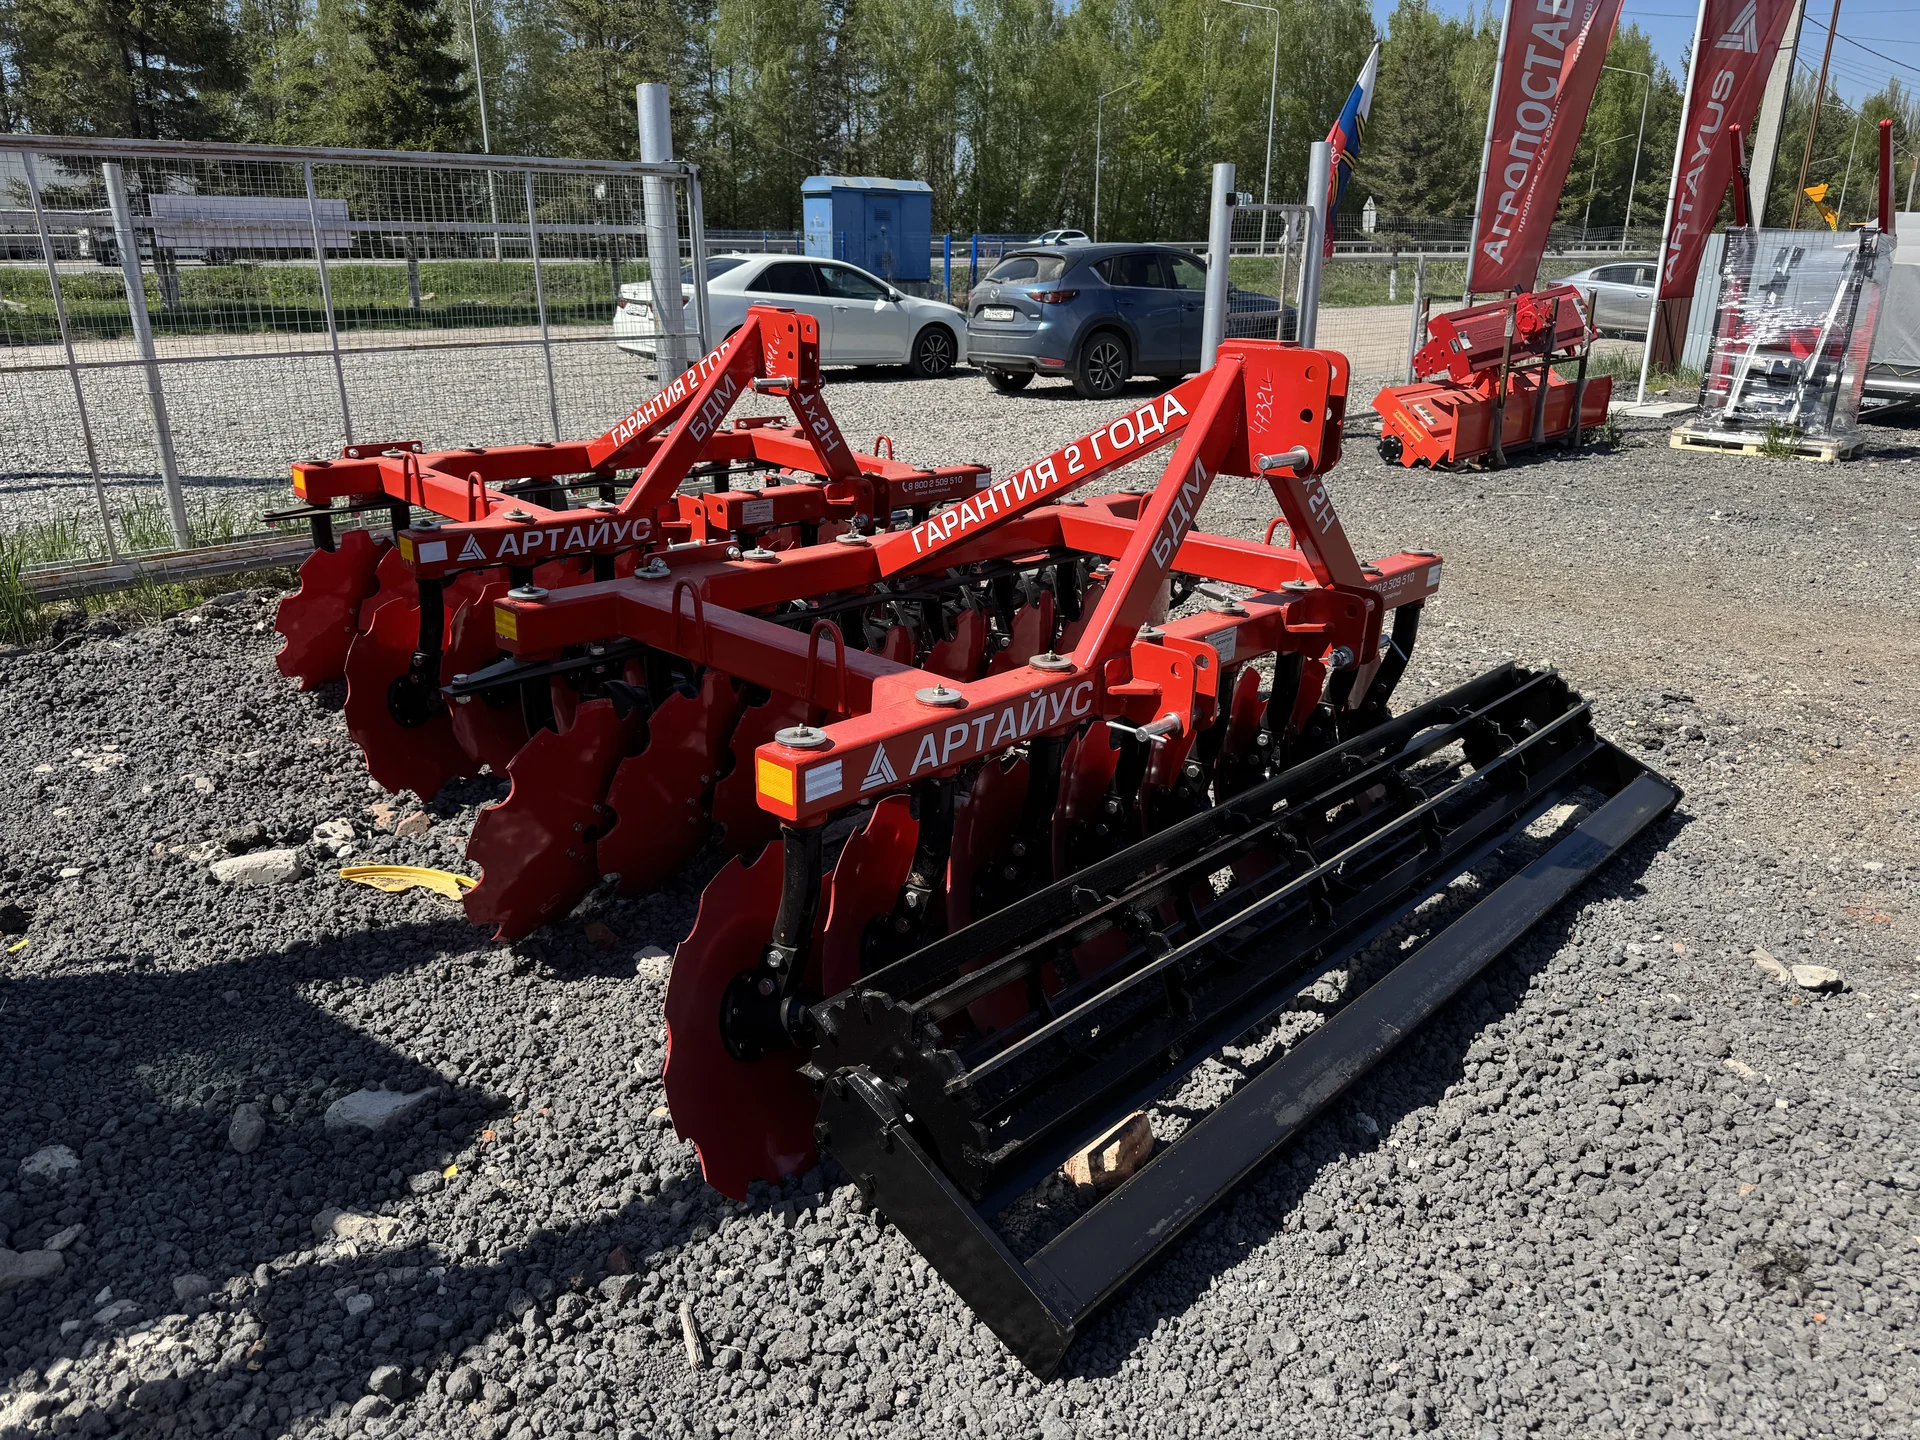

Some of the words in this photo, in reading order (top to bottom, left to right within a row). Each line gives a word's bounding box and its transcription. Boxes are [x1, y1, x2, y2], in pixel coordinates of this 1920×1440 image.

[1518, 175, 1538, 232] продажа
[1664, 69, 1735, 283] ARTAYUS
[611, 378, 687, 448] ГАРАНТИЯ
[687, 370, 699, 389] 2
[688, 373, 737, 442] БДМ
[908, 482, 914, 490] 8
[914, 480, 928, 490] 800
[929, 479, 934, 488] 2
[935, 477, 949, 487] 509
[950, 475, 963, 485] 510
[911, 457, 1058, 554] ГАРАНТИЯ
[1064, 444, 1085, 475] 2
[1090, 393, 1187, 461] ГОДА
[496, 517, 652, 558] АРТАЙУС
[1151, 455, 1207, 569] БДМ
[1388, 577, 1401, 590] 509
[1402, 571, 1415, 585] 510
[909, 680, 1094, 776] АРТАЙУС
